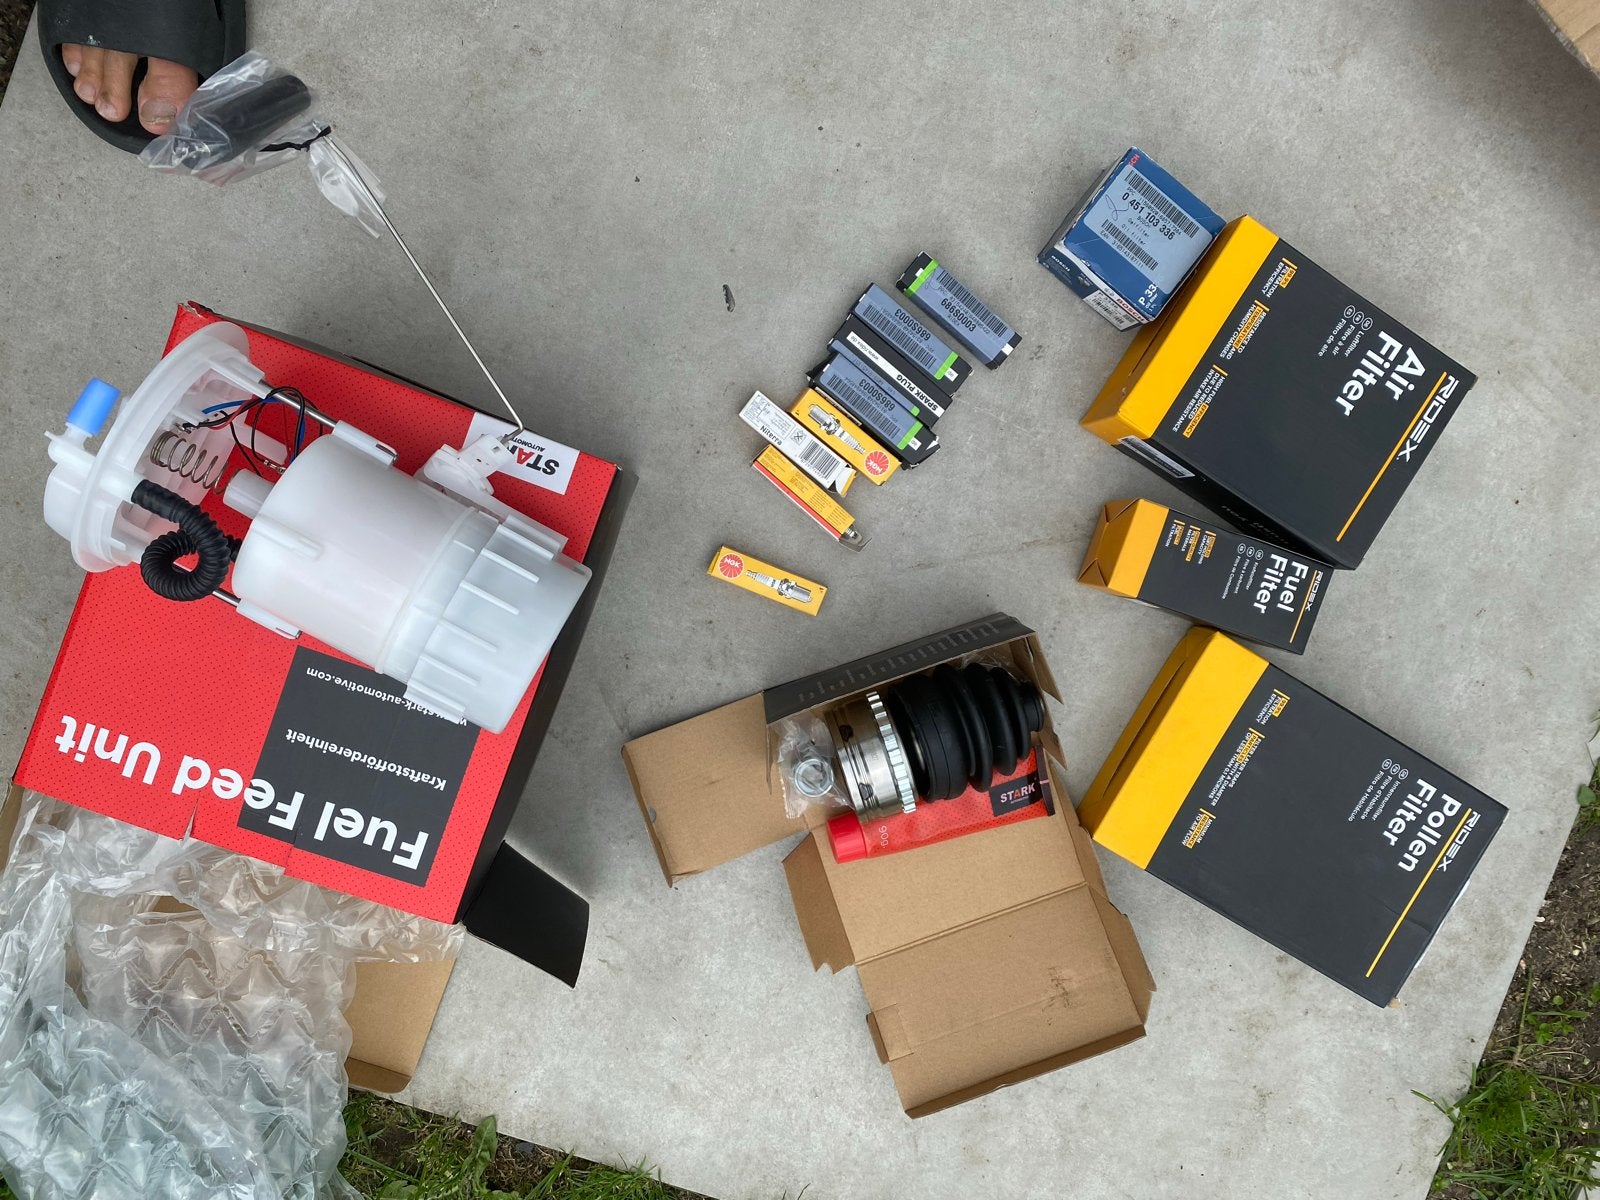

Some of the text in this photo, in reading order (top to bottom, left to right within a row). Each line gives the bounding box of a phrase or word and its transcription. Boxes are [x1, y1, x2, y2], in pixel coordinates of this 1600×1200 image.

[1121, 192, 1175, 240] 0 451 103 336
[1261, 261, 1284, 294] EFFICIENCY
[1265, 265, 1289, 297] FILTRATION
[940, 297, 976, 331] 686S0003
[1114, 298, 1145, 323] BOSCH
[1138, 296, 1145, 305] P
[894, 308, 931, 340] 686S0003
[1219, 303, 1256, 357] HUMIDITY CHANGES
[1224, 308, 1261, 360] TEMPERATURE AND
[1237, 311, 1266, 353] RESISTANCE TO
[1326, 334, 1334, 343] de
[1332, 318, 1346, 334] Filtro
[1341, 324, 1355, 340] Filtre
[1317, 343, 1328, 356] aire
[1344, 330, 1364, 357] Luftfilter
[896, 374, 915, 392] PLUG
[1335, 330, 1403, 416] Filter
[1384, 347, 1425, 400] Air
[858, 378, 895, 411] 686S0003
[914, 389, 938, 411] SPARK
[1172, 368, 1215, 432] INTAKE AIR RESISTANCE
[1183, 375, 1225, 436] HIGH FUEL EFFICIENCY
[1188, 372, 1220, 419] DUE TO REDUCED
[1397, 375, 1459, 462] RIDEX
[759, 425, 782, 445] Niterra
[867, 459, 882, 472] NGK
[1164, 523, 1176, 546] FILTRATION
[1181, 528, 1192, 551] MATERIALS
[1197, 534, 1207, 554] CAPACITY
[723, 557, 740, 568] NGK
[1253, 553, 1288, 613] Filter
[1276, 561, 1308, 612] Fuel
[1304, 570, 1323, 611] RIDEX
[1255, 693, 1276, 722] EFFICIENCY
[1260, 695, 1281, 725] FILTRATION
[1236, 739, 1246, 753] LESS
[1237, 735, 1256, 760] PARTICLES
[1244, 732, 1251, 740] OF
[285, 728, 446, 790] Kraftstoffördereinheit
[1226, 753, 1239, 768] THAN
[1228, 737, 1261, 787] FILTER LAYER TRAPS
[1228, 761, 1240, 775] WITH
[1208, 774, 1225, 798] MICRONS
[1366, 784, 1373, 792] de
[1371, 770, 1384, 784] Filtro
[1379, 775, 1392, 789] Filtre
[54, 715, 428, 869] Fuel Feed Unit
[1000, 782, 1035, 802] STARK
[1210, 779, 1229, 806] DIAMETER
[1371, 780, 1400, 820] Innenraumfilter
[1382, 778, 1437, 846] Filter
[1181, 813, 1203, 845] TO AIR FLOW
[1187, 815, 1207, 846] RESISTANCE
[1195, 818, 1212, 843] MINIMUM
[1397, 793, 1461, 871] Pollen
[1437, 811, 1480, 871] RIDEX
